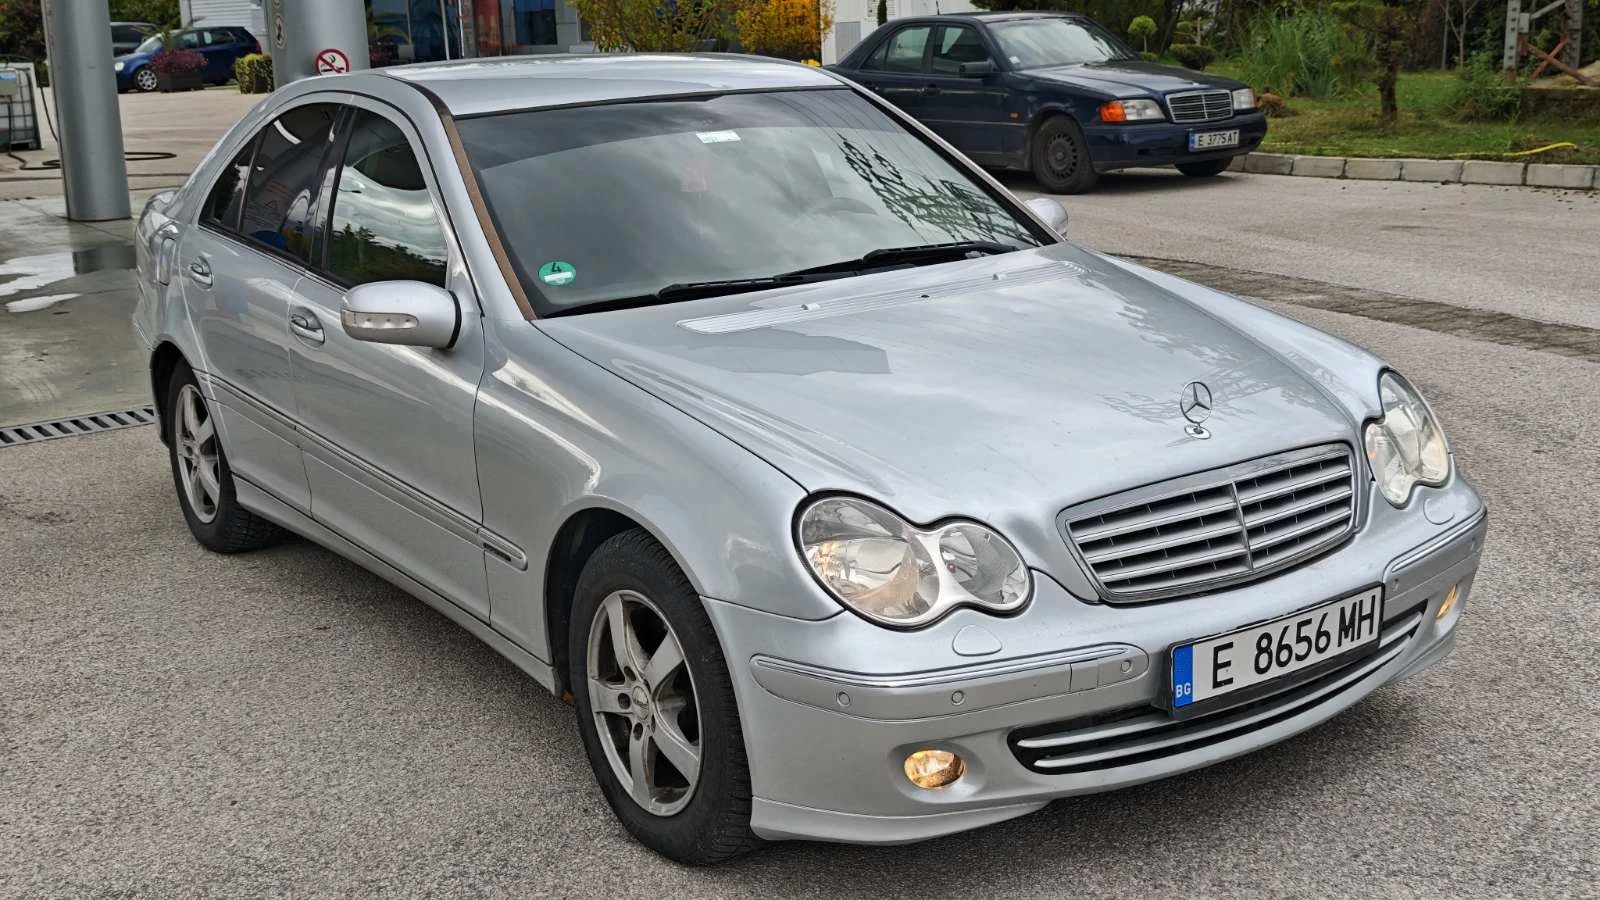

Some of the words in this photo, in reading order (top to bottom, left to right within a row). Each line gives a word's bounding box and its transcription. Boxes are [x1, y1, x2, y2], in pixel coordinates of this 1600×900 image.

[1198, 135, 1204, 146] E
[552, 262, 562, 272] 4
[1212, 641, 1234, 689] E
[1254, 612, 1331, 675] 8656
[1337, 594, 1376, 648] MH
[1175, 682, 1192, 698] BG
